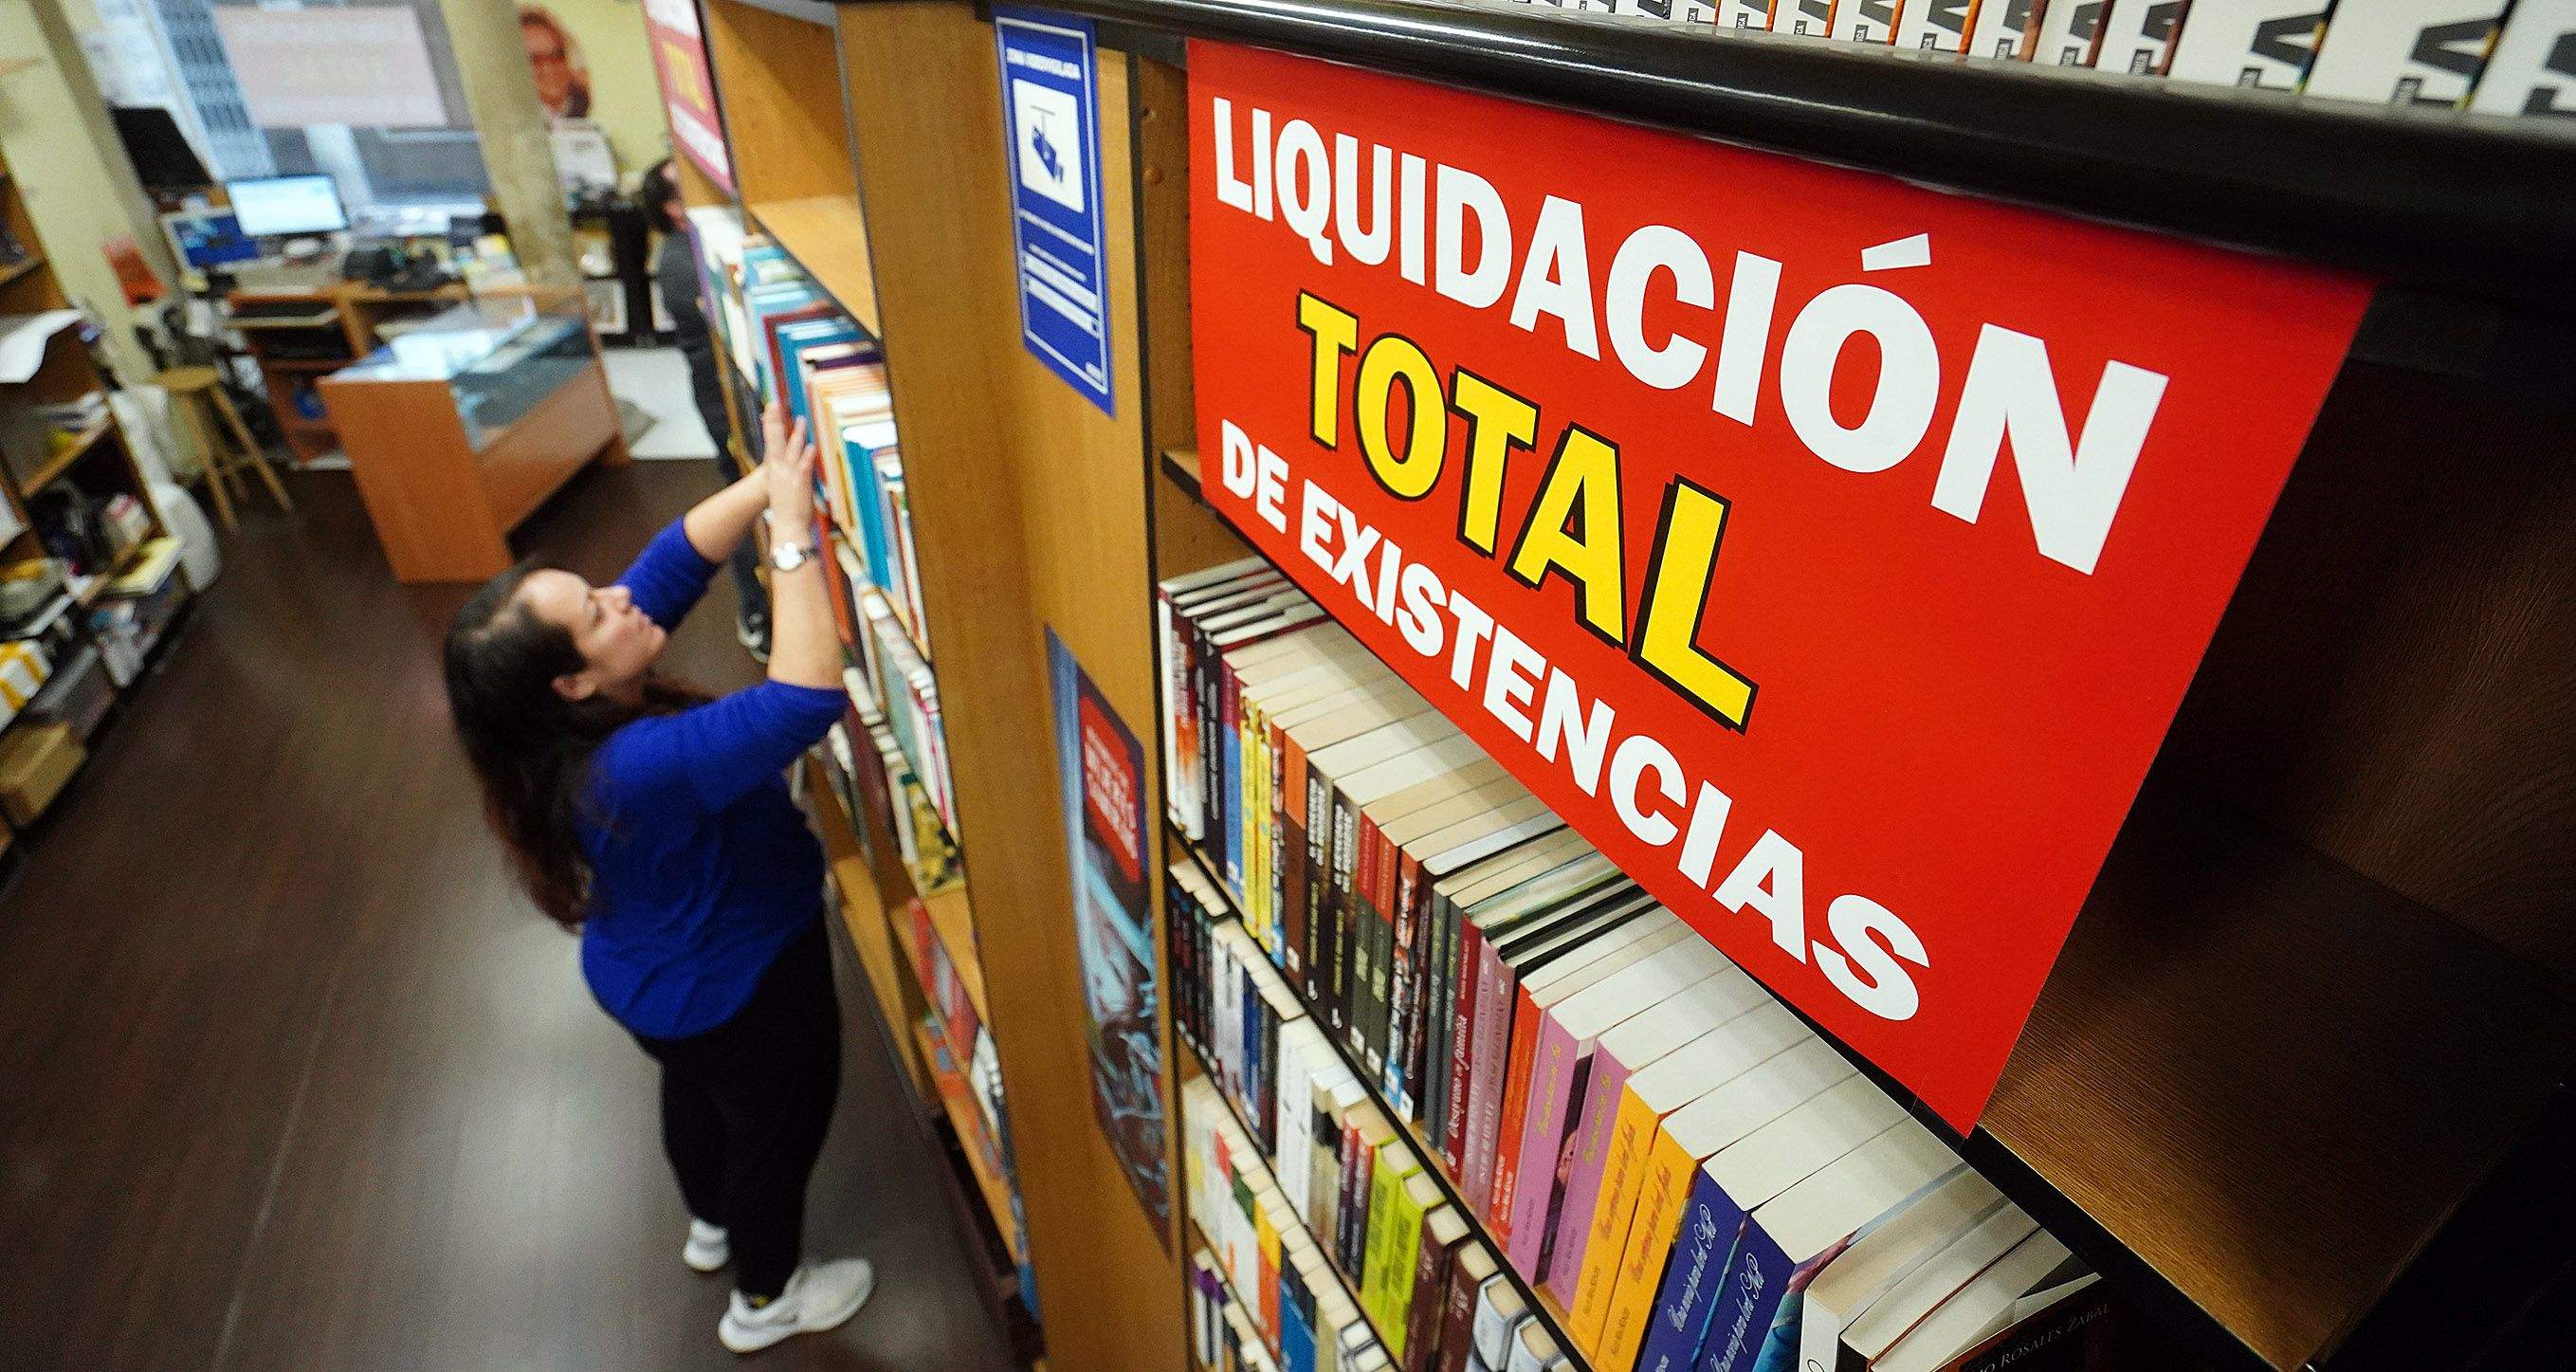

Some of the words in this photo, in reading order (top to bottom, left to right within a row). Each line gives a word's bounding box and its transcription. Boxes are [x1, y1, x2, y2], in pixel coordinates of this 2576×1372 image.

[1214, 97, 2169, 576] LIQUIDACIÓN
[1296, 288, 1759, 735] TOTAL
[1221, 419, 1289, 534] DE
[1300, 479, 1930, 1021] EXISTENCIAS
